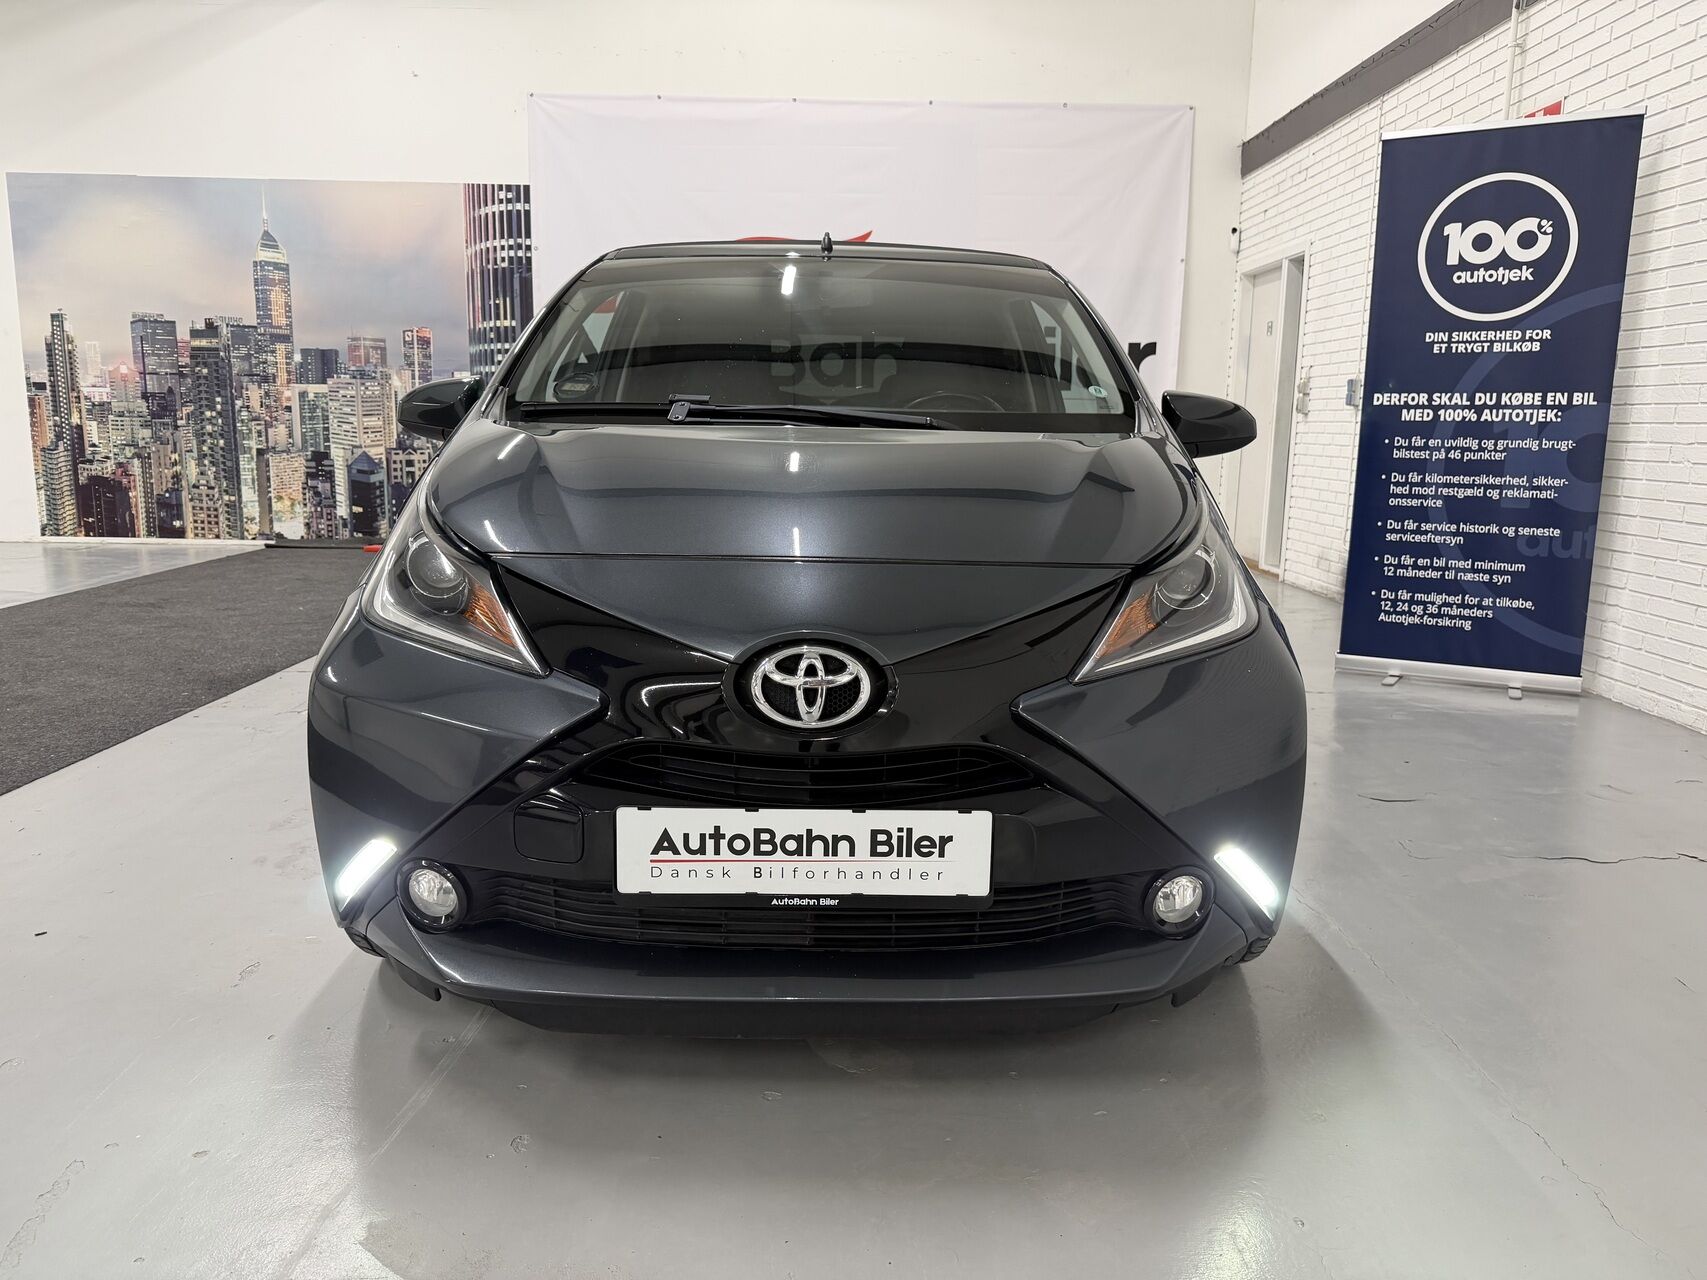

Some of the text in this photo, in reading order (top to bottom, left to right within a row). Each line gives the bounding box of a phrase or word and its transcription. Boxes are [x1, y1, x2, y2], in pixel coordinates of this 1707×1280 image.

[1452, 266, 1534, 285] autotjek
[1426, 330, 1552, 342] DIN SIKKERHED FOR
[1433, 342, 1541, 353] ET TRYGT BILKØB
[1373, 392, 1598, 406] DERFOR SKAL DU KØBE EN BIL
[1401, 408, 1562, 424] MED 100% AUTOTJEK:
[1394, 436, 1576, 451] Du får en uvildig og grundig brugt-
[1393, 448, 1506, 462] bilstest på 46 punkter
[1391, 472, 1568, 486] Du får kilometersikkerhed, sikker-
[1390, 484, 1558, 499] hed mod restgæld og reklamati-
[1389, 496, 1442, 507] onsservice
[1387, 520, 1560, 536] Du får service historik og seneste
[1386, 532, 1464, 546] serviceeftersyn
[1384, 555, 1526, 572] Du får en bil med minimum
[1383, 567, 1511, 585] 12 måneder til næste syn
[1381, 589, 1535, 610] Du får mulighed for at tilkøbe,
[1380, 601, 1493, 618] 12, 24 og 36 måneders
[1378, 612, 1472, 630] Autotjek-forsikring
[650, 825, 954, 858] AutoBahn Biler
[650, 866, 944, 881] Dansk Bilforhandler
[771, 897, 839, 906] AutoBahn Biler
